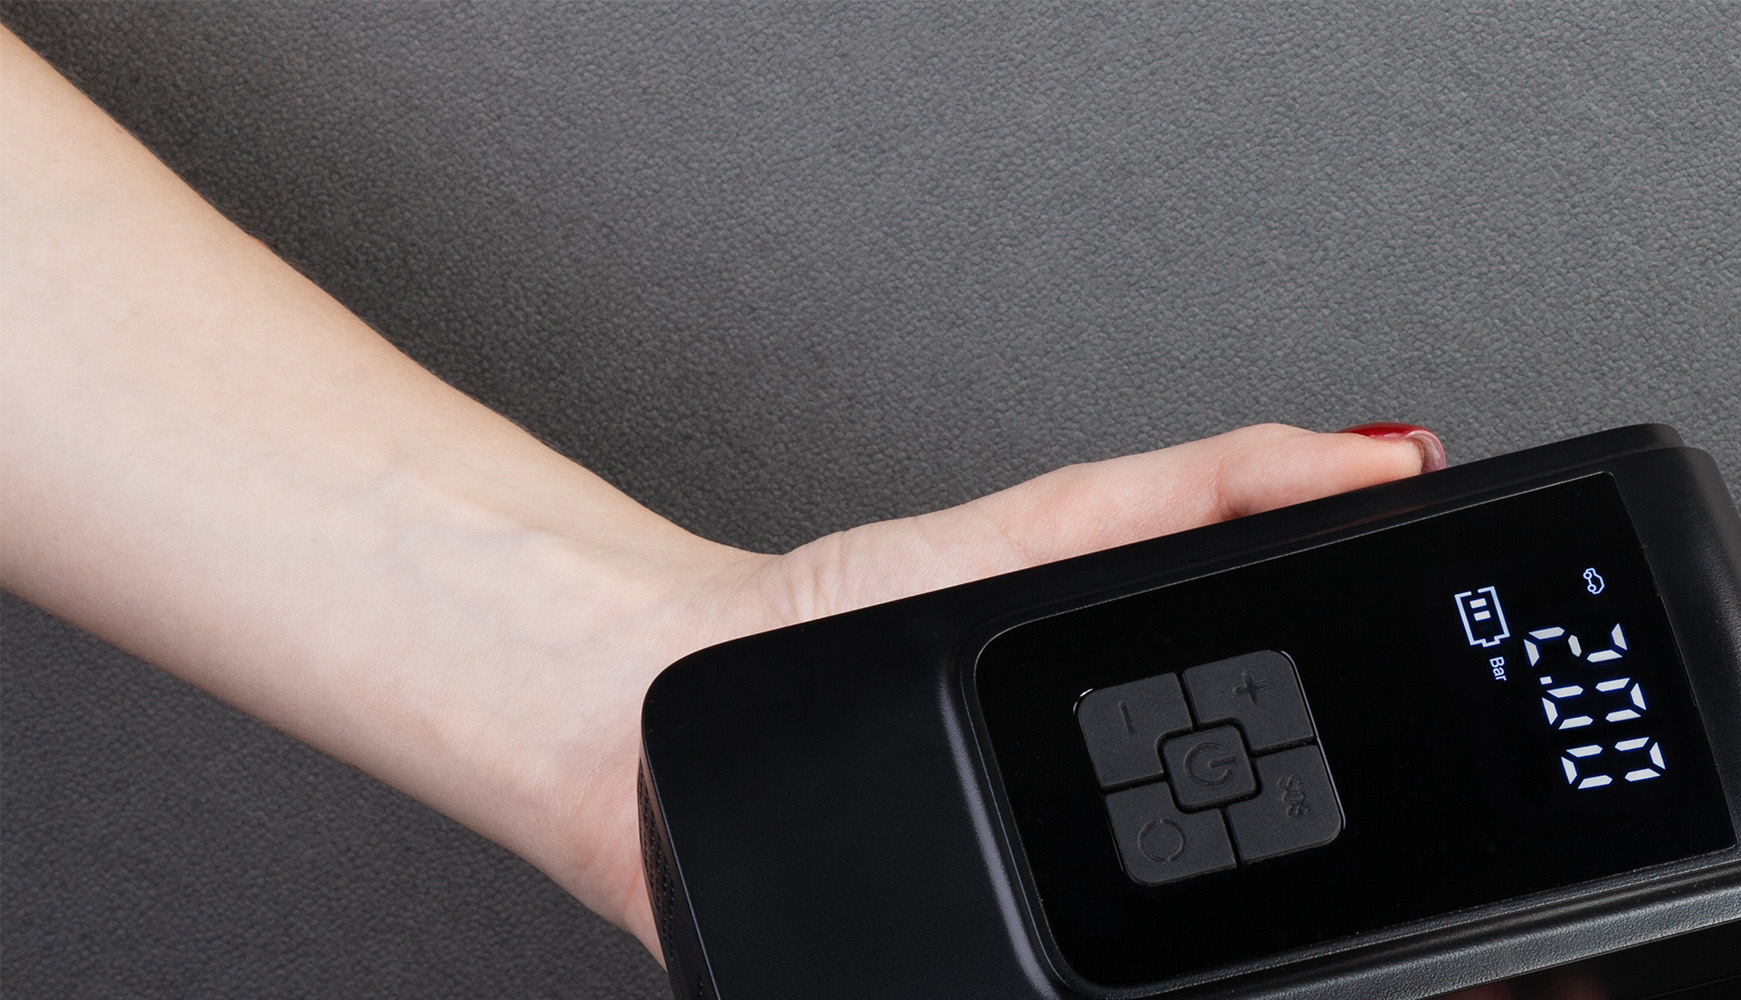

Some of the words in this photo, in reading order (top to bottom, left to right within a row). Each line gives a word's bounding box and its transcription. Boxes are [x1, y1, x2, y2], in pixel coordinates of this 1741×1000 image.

[1489, 656, 1507, 682] Bar
[1523, 622, 1667, 790] 2.00
[1277, 774, 1310, 818] SOS
